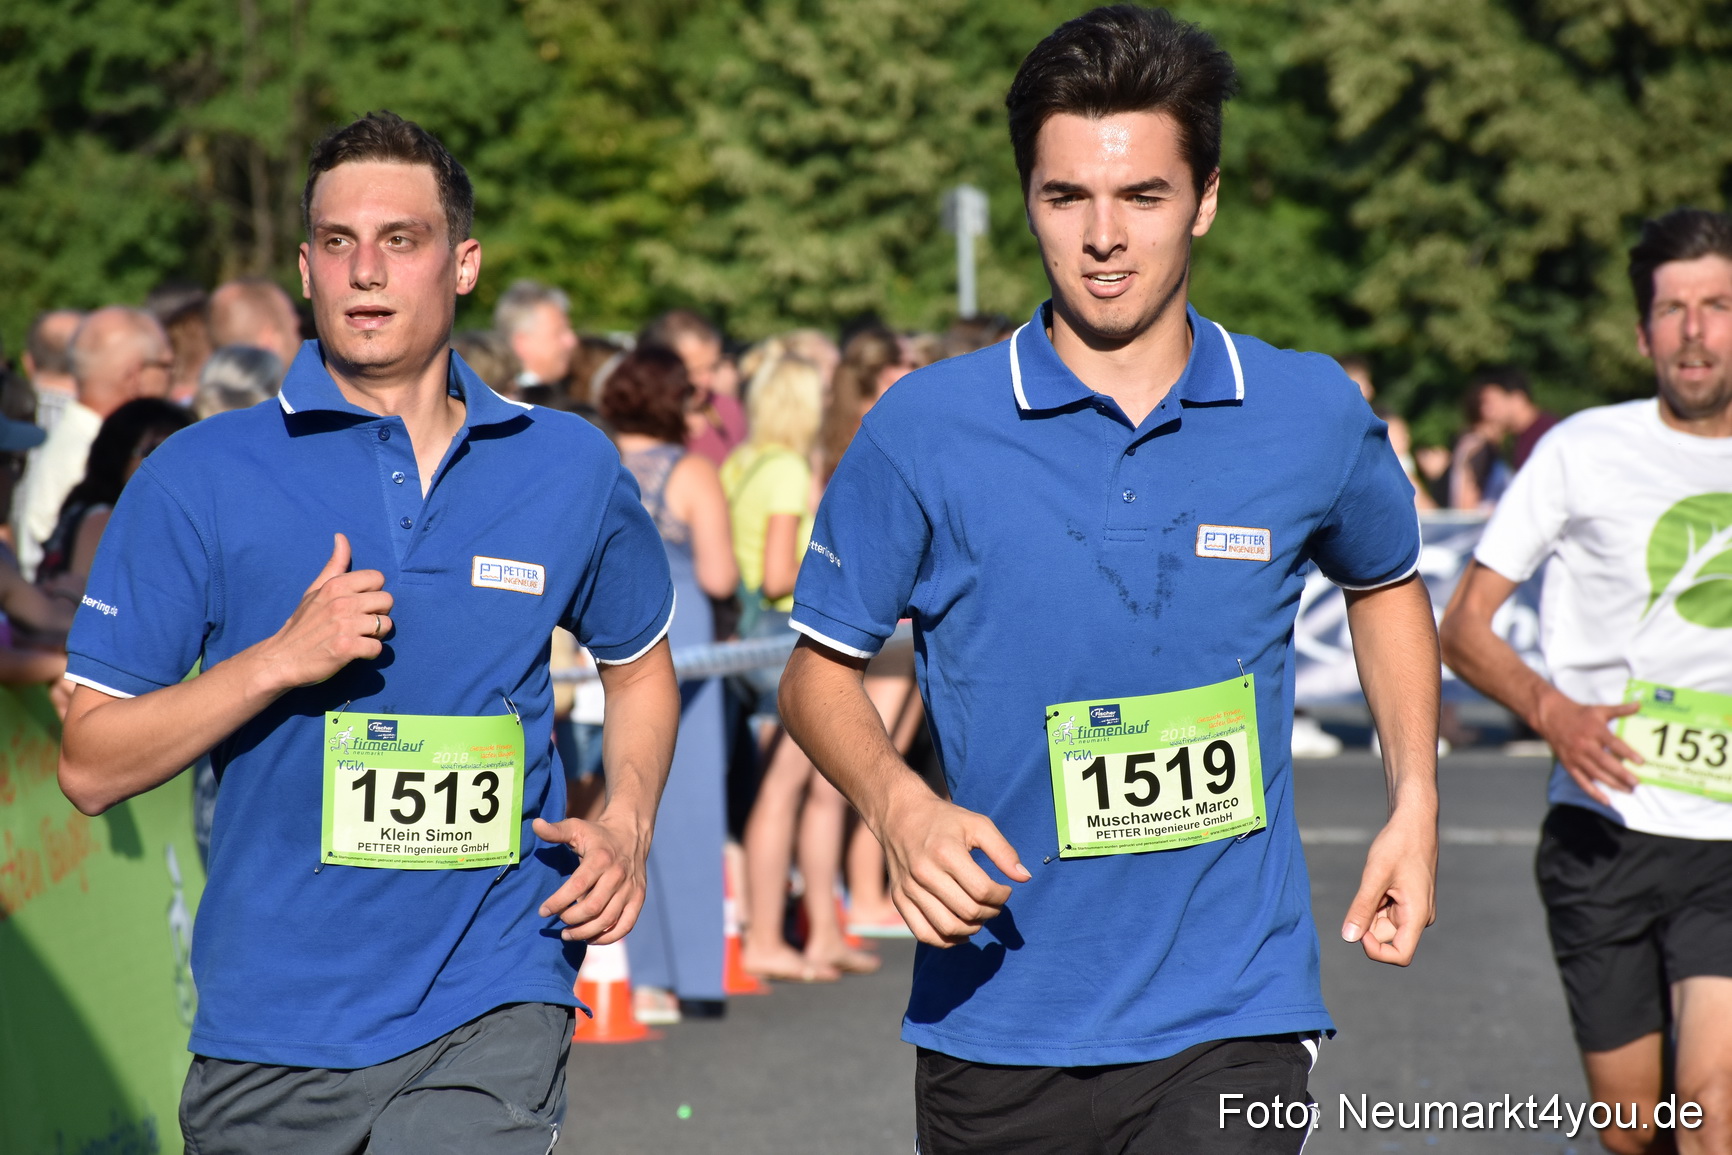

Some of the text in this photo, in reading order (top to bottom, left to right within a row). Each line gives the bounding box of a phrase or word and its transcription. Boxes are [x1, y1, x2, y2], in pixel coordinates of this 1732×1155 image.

[1229, 533, 1265, 545] PETTER
[504, 565, 538, 580] PETTER
[1078, 720, 1150, 739] firmenlauf
[1160, 725, 1197, 742] 2018
[353, 737, 425, 752] firmenlauf
[432, 752, 469, 763] 2018
[1082, 739, 1236, 810] 1519
[352, 769, 499, 824] 1513
[1087, 797, 1239, 828] Muschaweck Marco
[1096, 812, 1233, 840] PETTER Ingenieure GmbH
[380, 828, 472, 842] Klein Simon
[358, 842, 490, 856] PETTER Ingenieure GmbH
